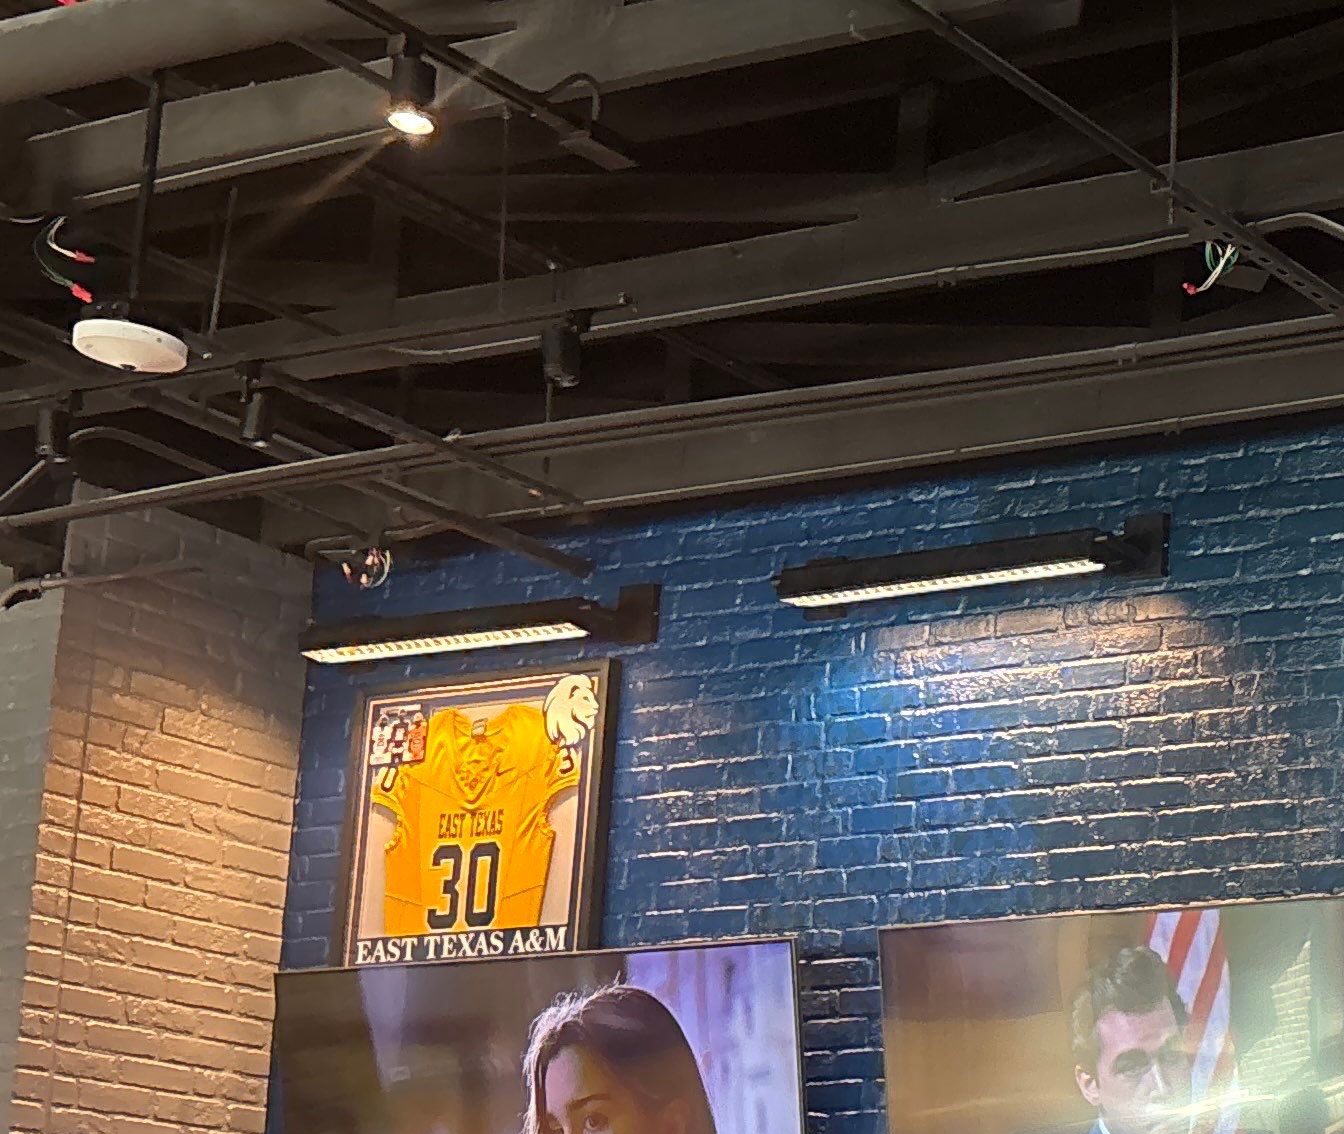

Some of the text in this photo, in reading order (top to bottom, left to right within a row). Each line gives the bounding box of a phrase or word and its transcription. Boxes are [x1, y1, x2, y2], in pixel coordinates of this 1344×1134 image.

[438, 809, 504, 838] EAST TEXAS
[426, 841, 501, 930] 30
[355, 926, 567, 965] EAST TEXAS A&M
